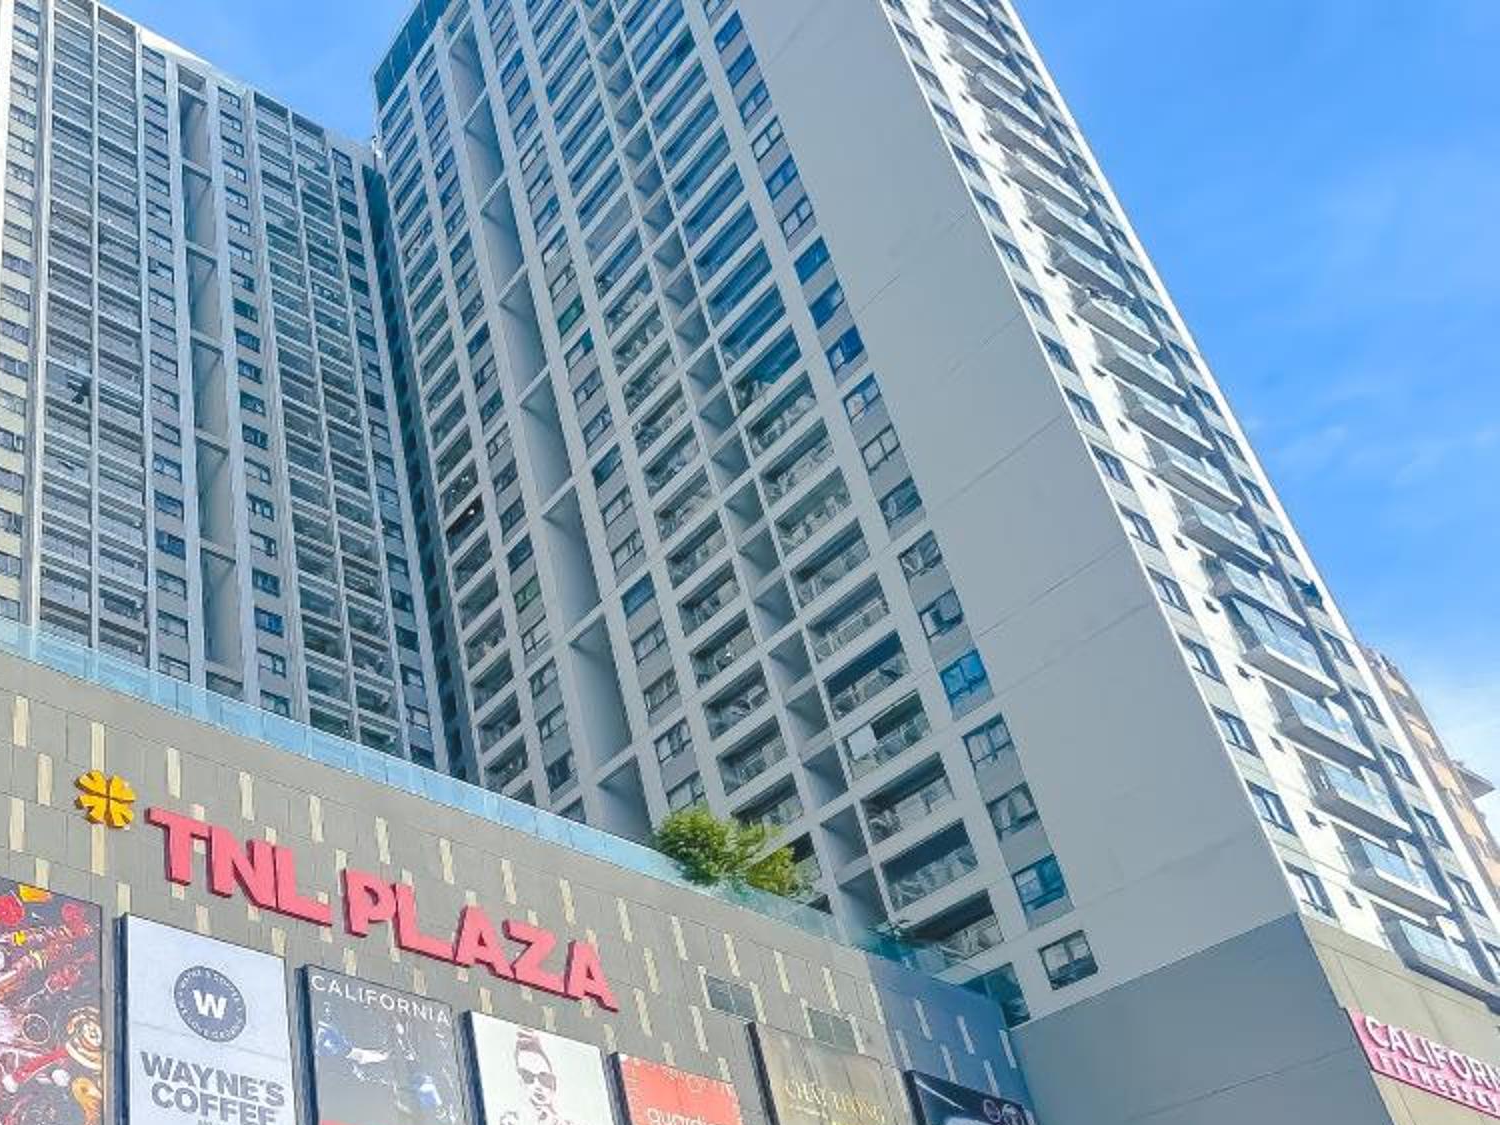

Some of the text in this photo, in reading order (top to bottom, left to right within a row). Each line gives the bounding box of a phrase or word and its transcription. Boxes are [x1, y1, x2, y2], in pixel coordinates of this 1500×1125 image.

[145, 806, 332, 927] TNL
[344, 868, 619, 1013] PLAZA
[192, 988, 228, 1020] W
[311, 975, 451, 1027] CALIFORNIA
[140, 1051, 285, 1107] WAYNE'S
